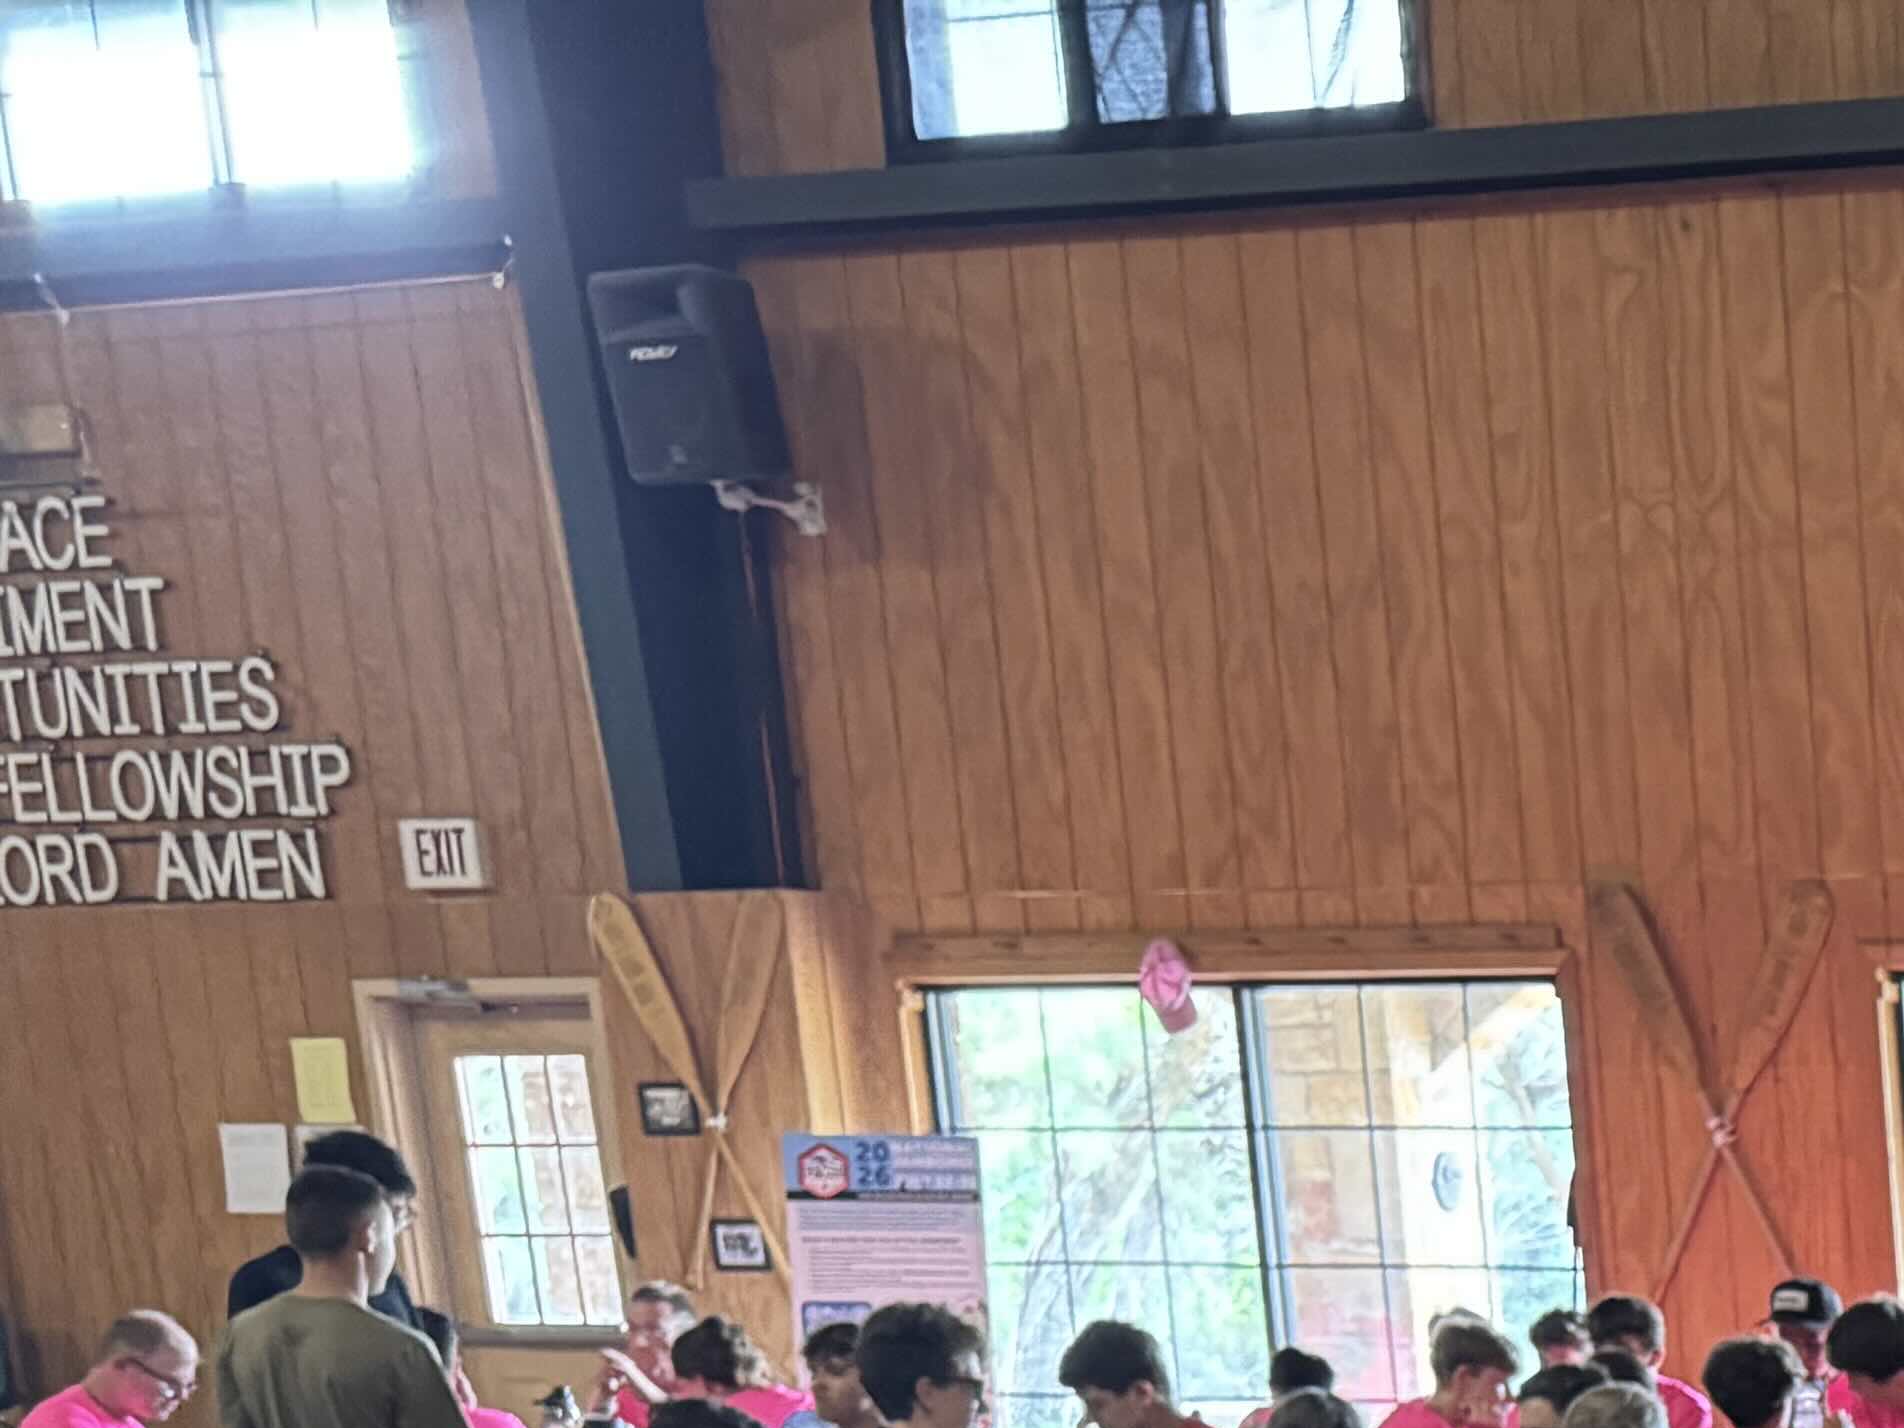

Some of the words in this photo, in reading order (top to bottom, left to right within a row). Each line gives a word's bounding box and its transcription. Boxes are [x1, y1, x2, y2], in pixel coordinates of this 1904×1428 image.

[0, 832, 118, 905] ORD
[157, 828, 325, 900] AMEN
[416, 827, 467, 879] EXIT
[855, 1140, 890, 1163] 20
[857, 1165, 890, 1186] 26
